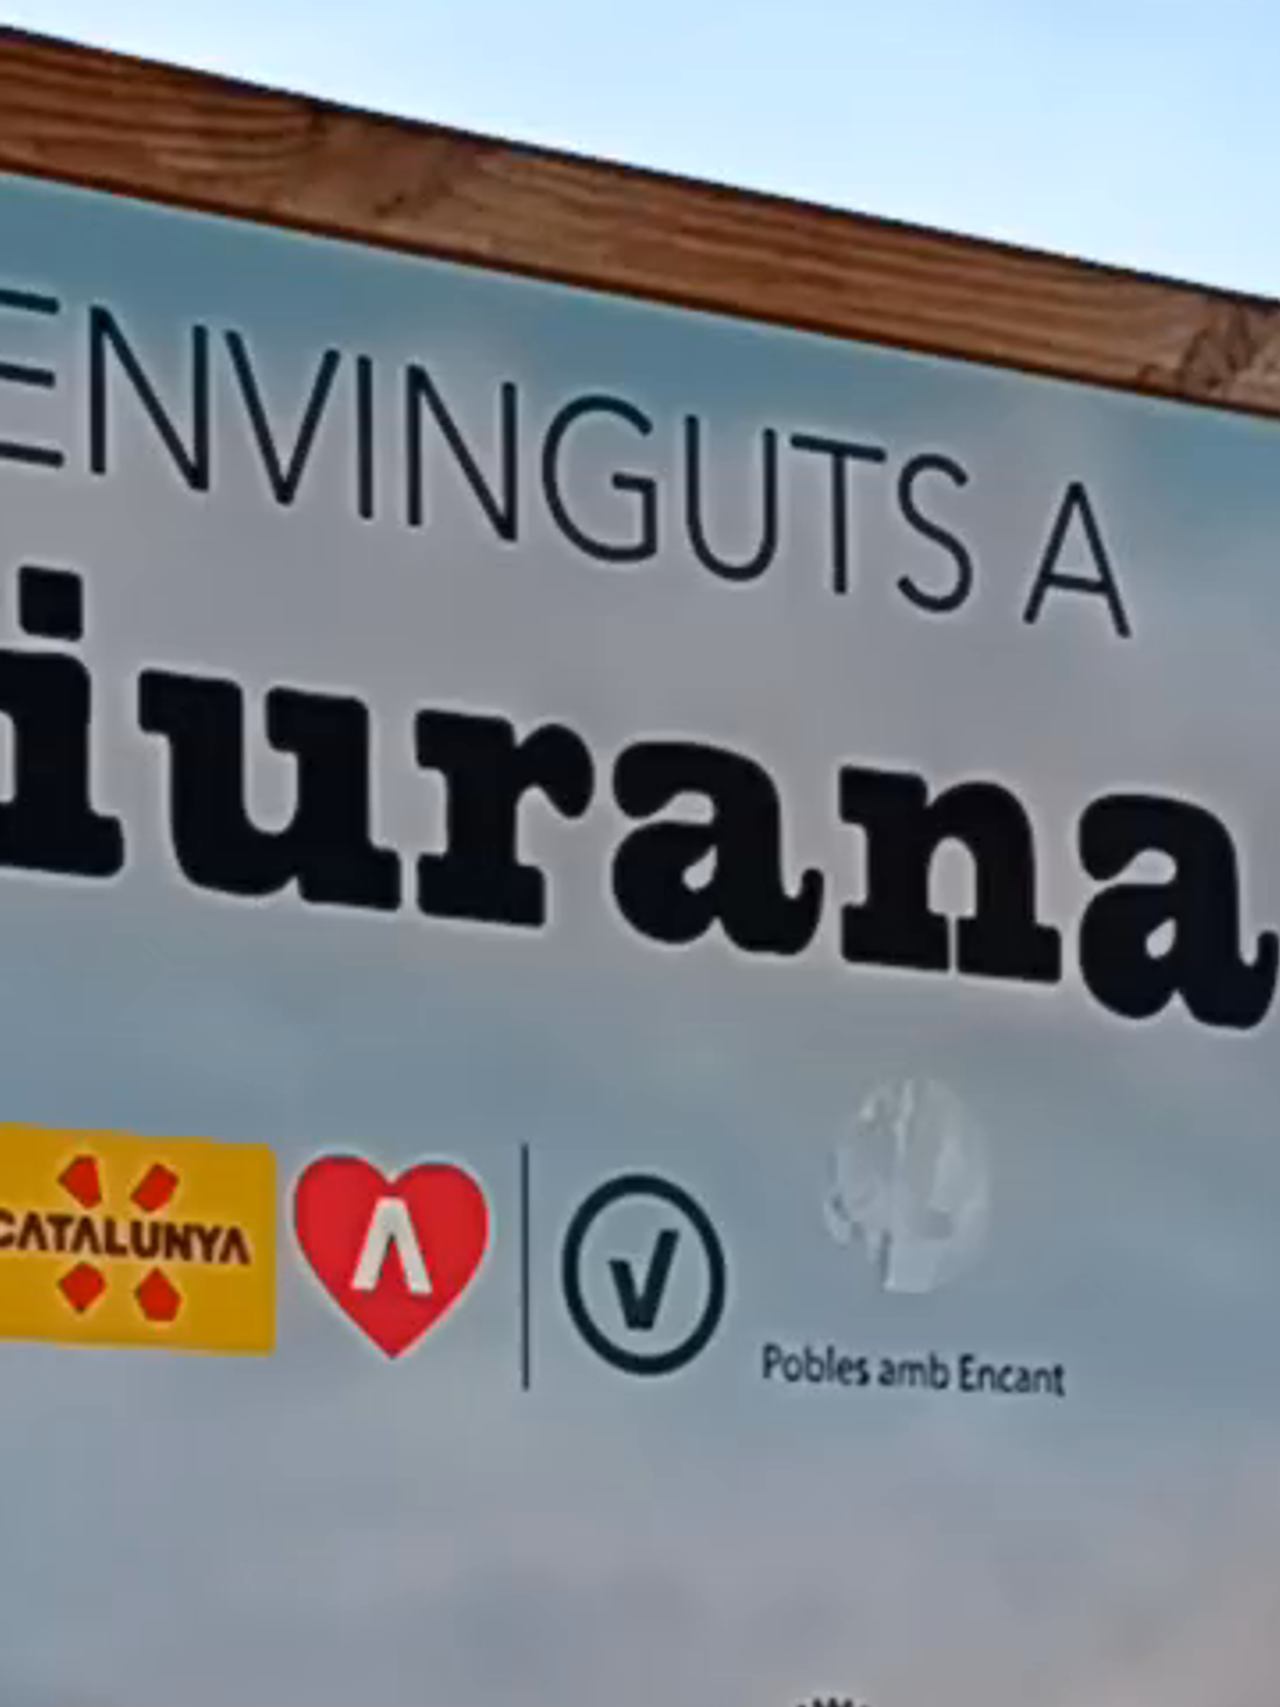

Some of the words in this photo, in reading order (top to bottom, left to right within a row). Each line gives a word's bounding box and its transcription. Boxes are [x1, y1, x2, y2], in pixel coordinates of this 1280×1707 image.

[1022, 479, 1132, 639] A
[761, 1343, 871, 1387] Pobles
[876, 1354, 951, 1391] amb
[956, 1355, 1067, 1397] Encant
